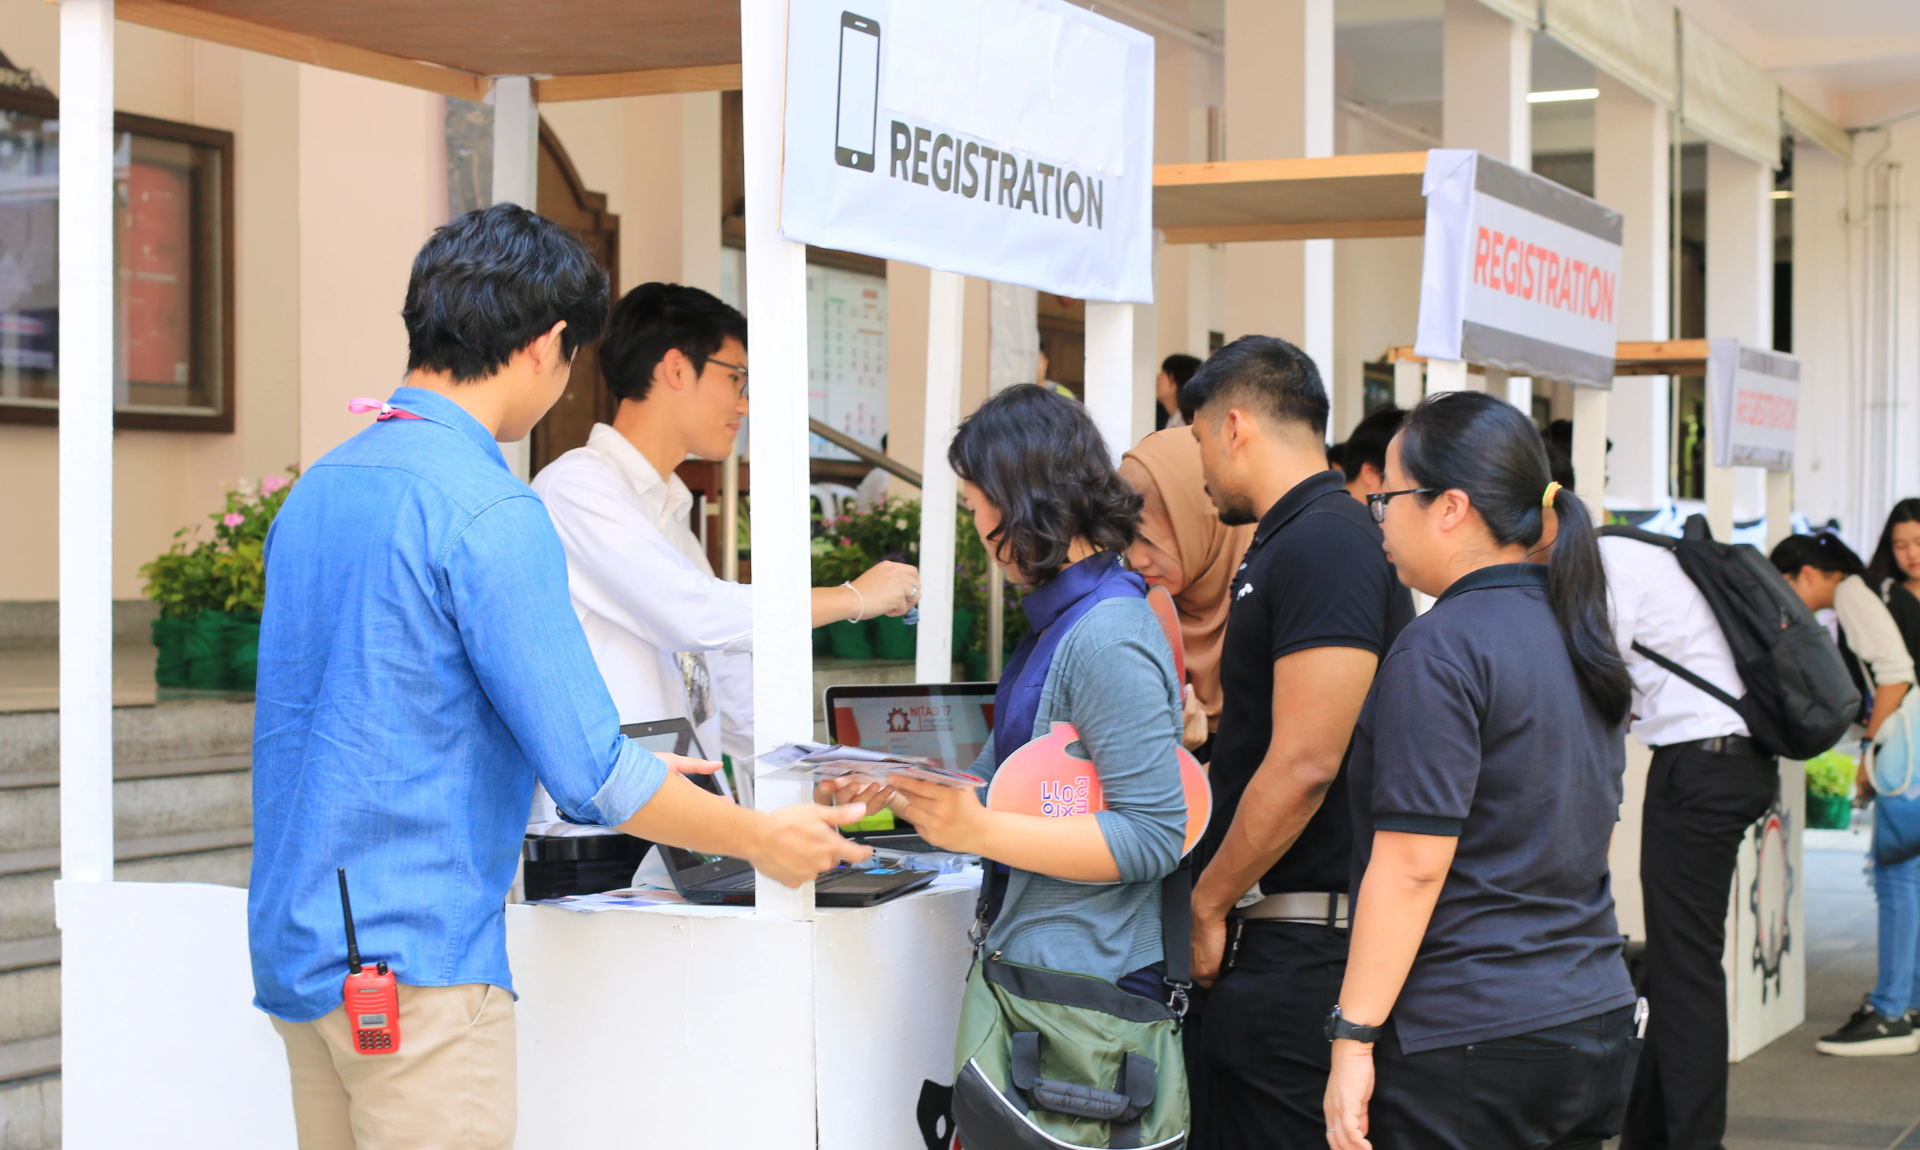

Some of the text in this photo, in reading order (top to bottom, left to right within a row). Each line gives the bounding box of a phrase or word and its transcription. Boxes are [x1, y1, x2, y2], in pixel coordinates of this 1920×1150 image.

[890, 119, 1103, 230] REGISTRATION
[1474, 226, 1616, 323] REGISTRATION
[1041, 776, 1089, 804] 2017
